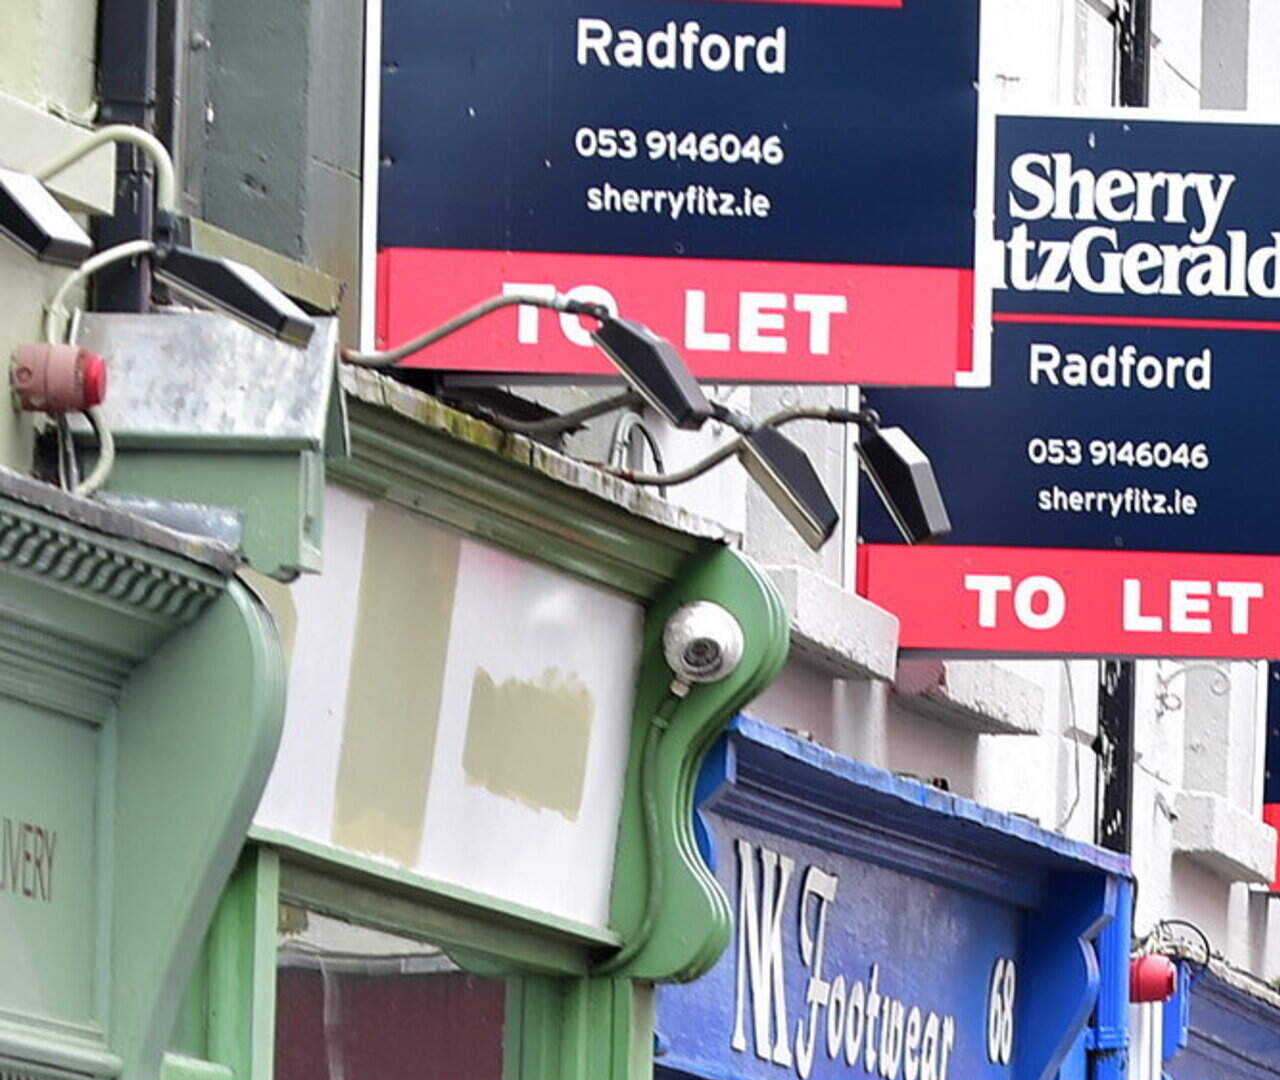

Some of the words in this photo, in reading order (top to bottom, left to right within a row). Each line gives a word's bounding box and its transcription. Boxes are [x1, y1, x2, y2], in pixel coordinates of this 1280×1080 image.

[575, 18, 788, 74] Radford
[574, 128, 638, 160] 053
[645, 132, 784, 166] 9146046
[586, 183, 772, 220] sherryfitz.ie
[1008, 151, 1237, 244] Sherry
[684, 289, 848, 356] LET
[1029, 342, 1212, 391] Radford
[1027, 438, 1083, 466] 053
[1089, 441, 1210, 470] 9146046
[1038, 485, 1198, 517] sherryfitz.ie
[964, 573, 1067, 631] TO
[1121, 578, 1265, 636] LET
[0, 816, 57, 903] IVERY
[986, 957, 1017, 1066] 68
